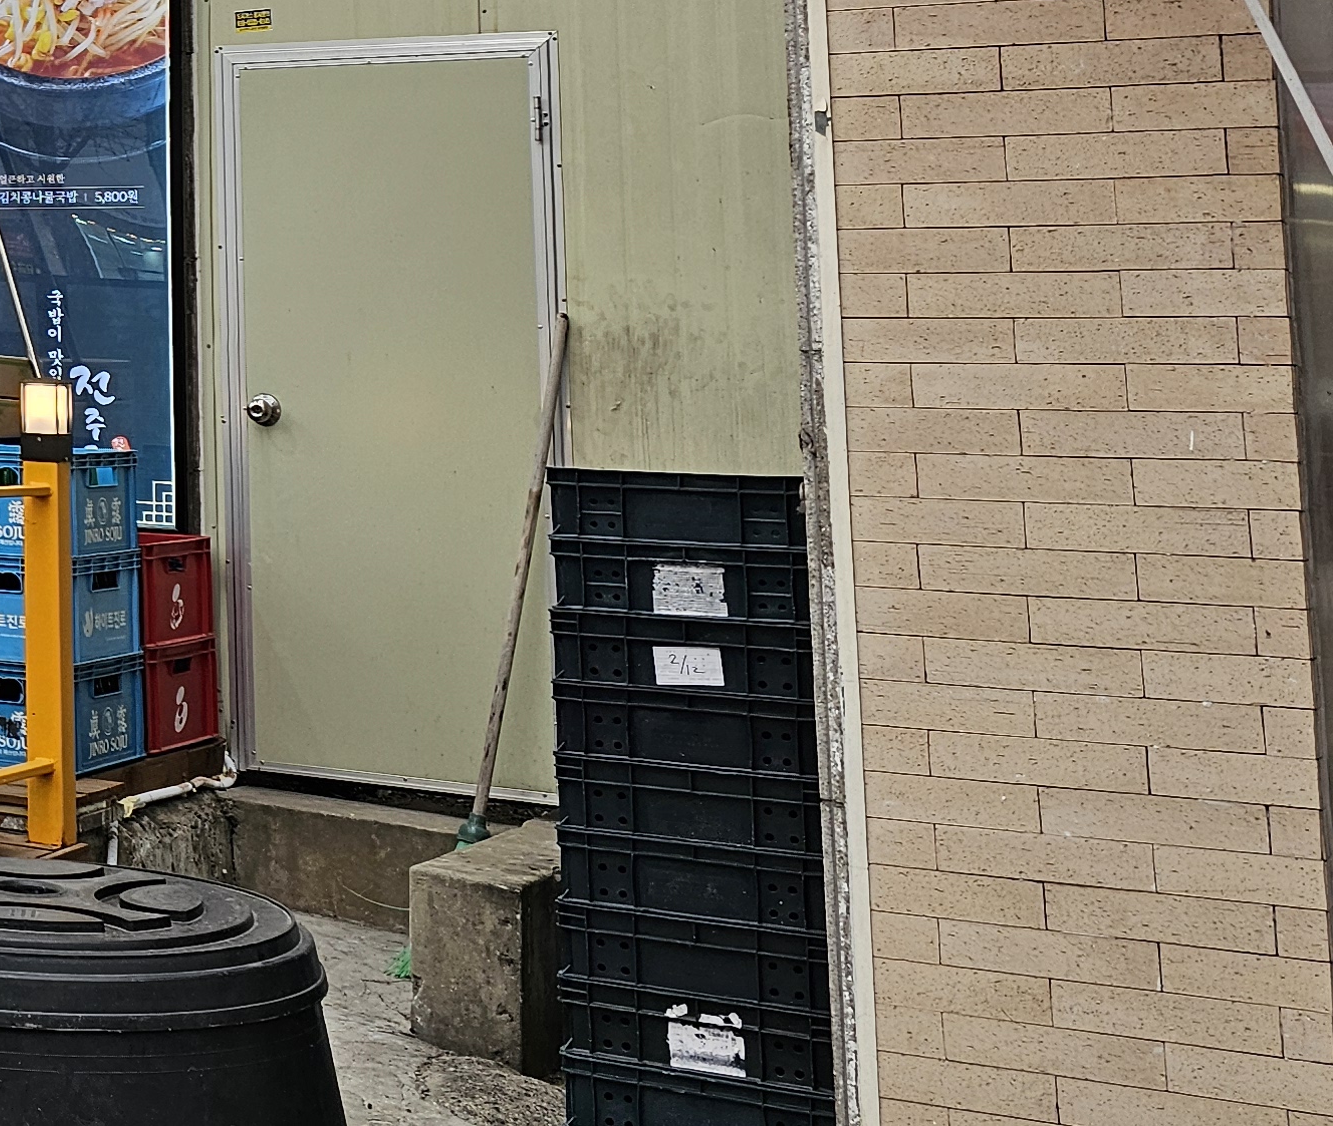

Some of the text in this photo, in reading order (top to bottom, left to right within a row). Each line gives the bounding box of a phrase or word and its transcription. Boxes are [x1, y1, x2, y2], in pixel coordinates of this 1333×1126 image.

[36, 173, 66, 185] 시원한
[94, 189, 139, 205] 5,800원
[46, 289, 65, 343] 국밥이
[69, 365, 116, 451] 전주
[84, 524, 123, 546] JINRO SOJU
[94, 610, 127, 631] 하이트진로
[88, 734, 128, 760] JINRO SOJU
